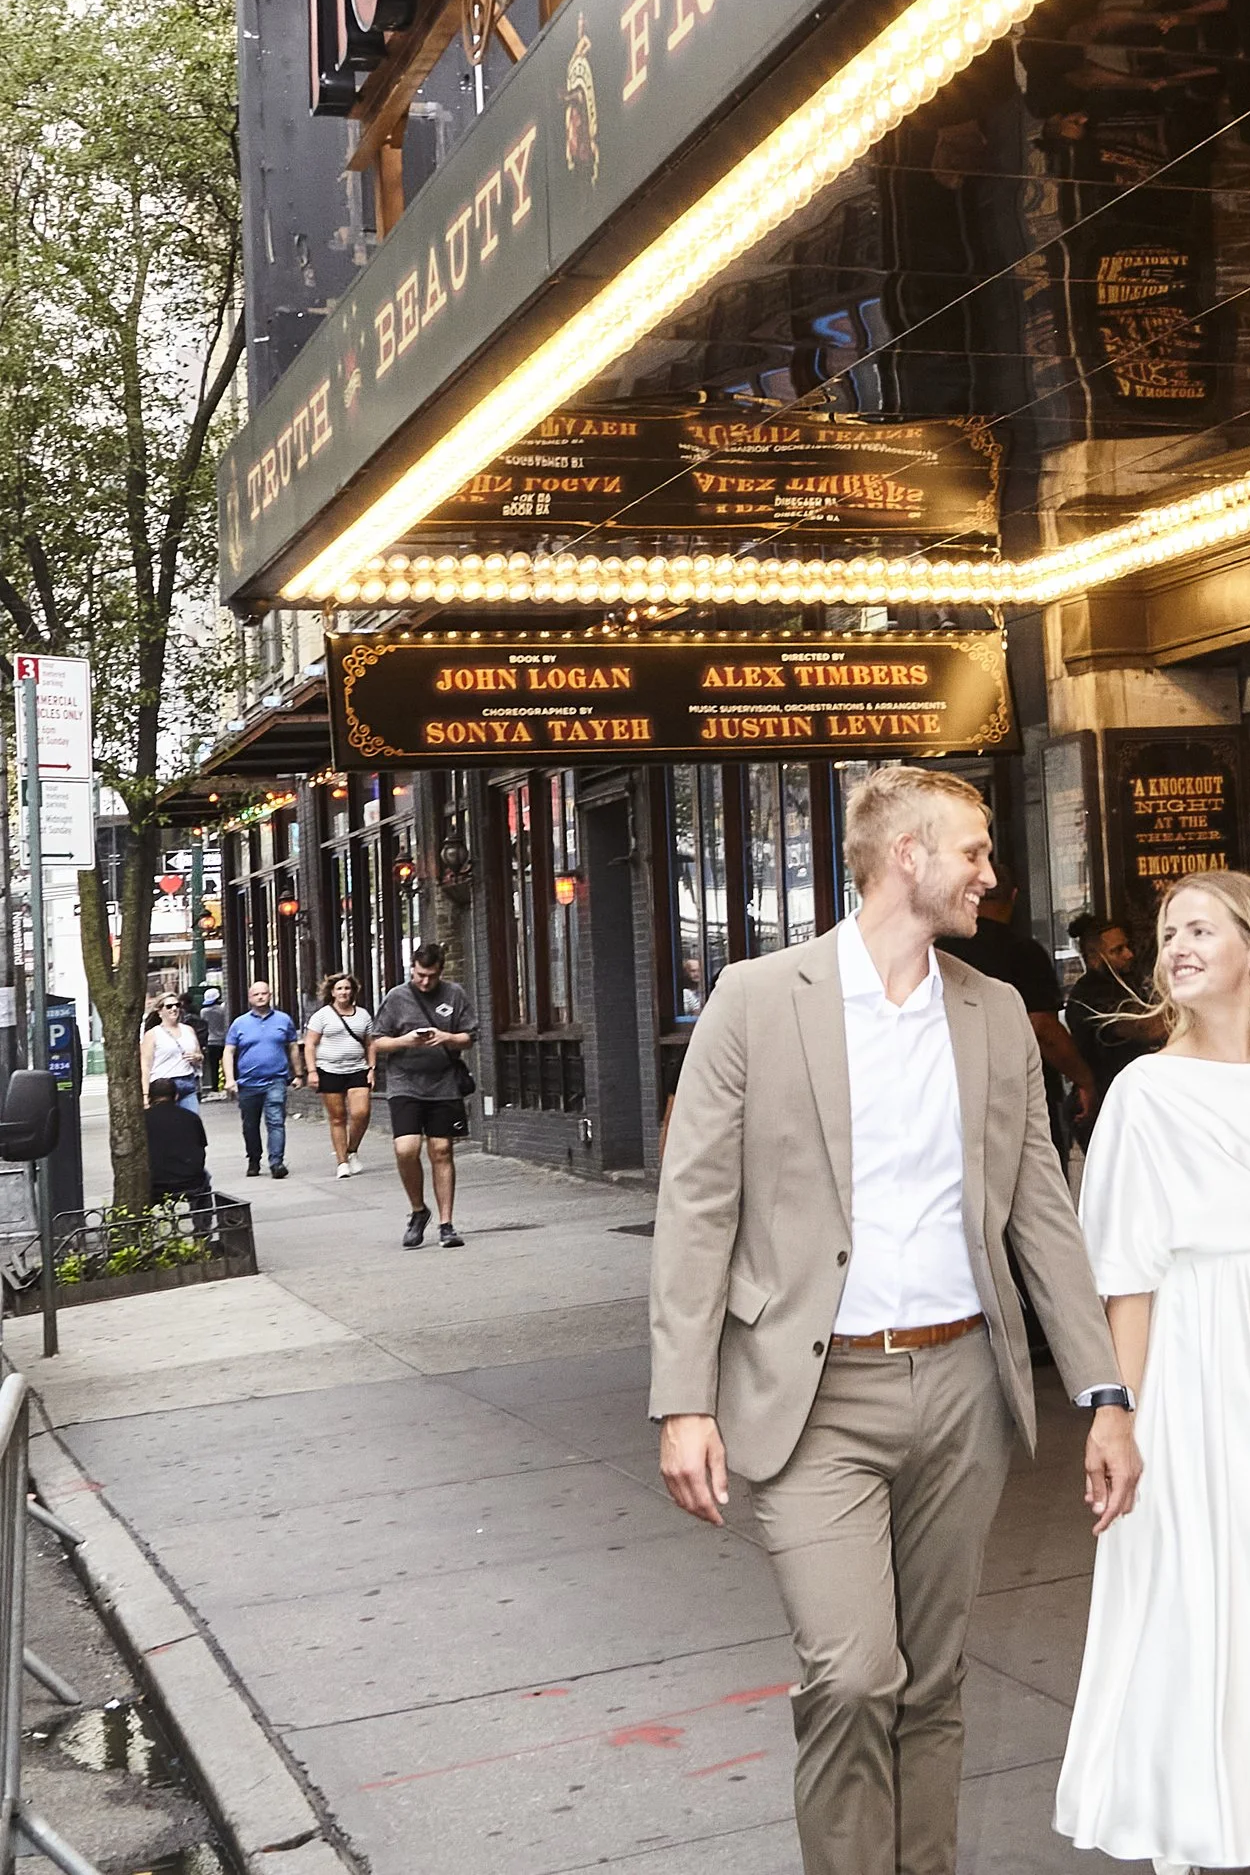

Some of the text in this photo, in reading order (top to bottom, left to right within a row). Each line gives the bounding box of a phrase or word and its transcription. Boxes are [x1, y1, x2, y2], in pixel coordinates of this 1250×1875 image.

[374, 125, 537, 379] BEAUTY
[246, 378, 334, 521] TRUTH
[509, 654, 556, 664] BOOK BY
[781, 652, 845, 662] DIRECTED BY
[22, 659, 36, 679] 3
[436, 667, 631, 691] JOHN LOGAN
[702, 665, 928, 688] ALEX TIMBERS
[63, 709, 83, 720] ONLY
[482, 706, 593, 718] CHOREOGRAPHED BY
[689, 705, 718, 714] MUSIC
[425, 718, 651, 745] SONYA TAYEH
[701, 713, 941, 739] JUSTIN LEVINE
[1150, 776, 1224, 797] KNOCKOUT
[1135, 798, 1225, 814] NIGHT
[1153, 815, 1208, 830] AT THE
[1138, 853, 1229, 876] EMOTIONAL
[49, 1024, 65, 1047] P
